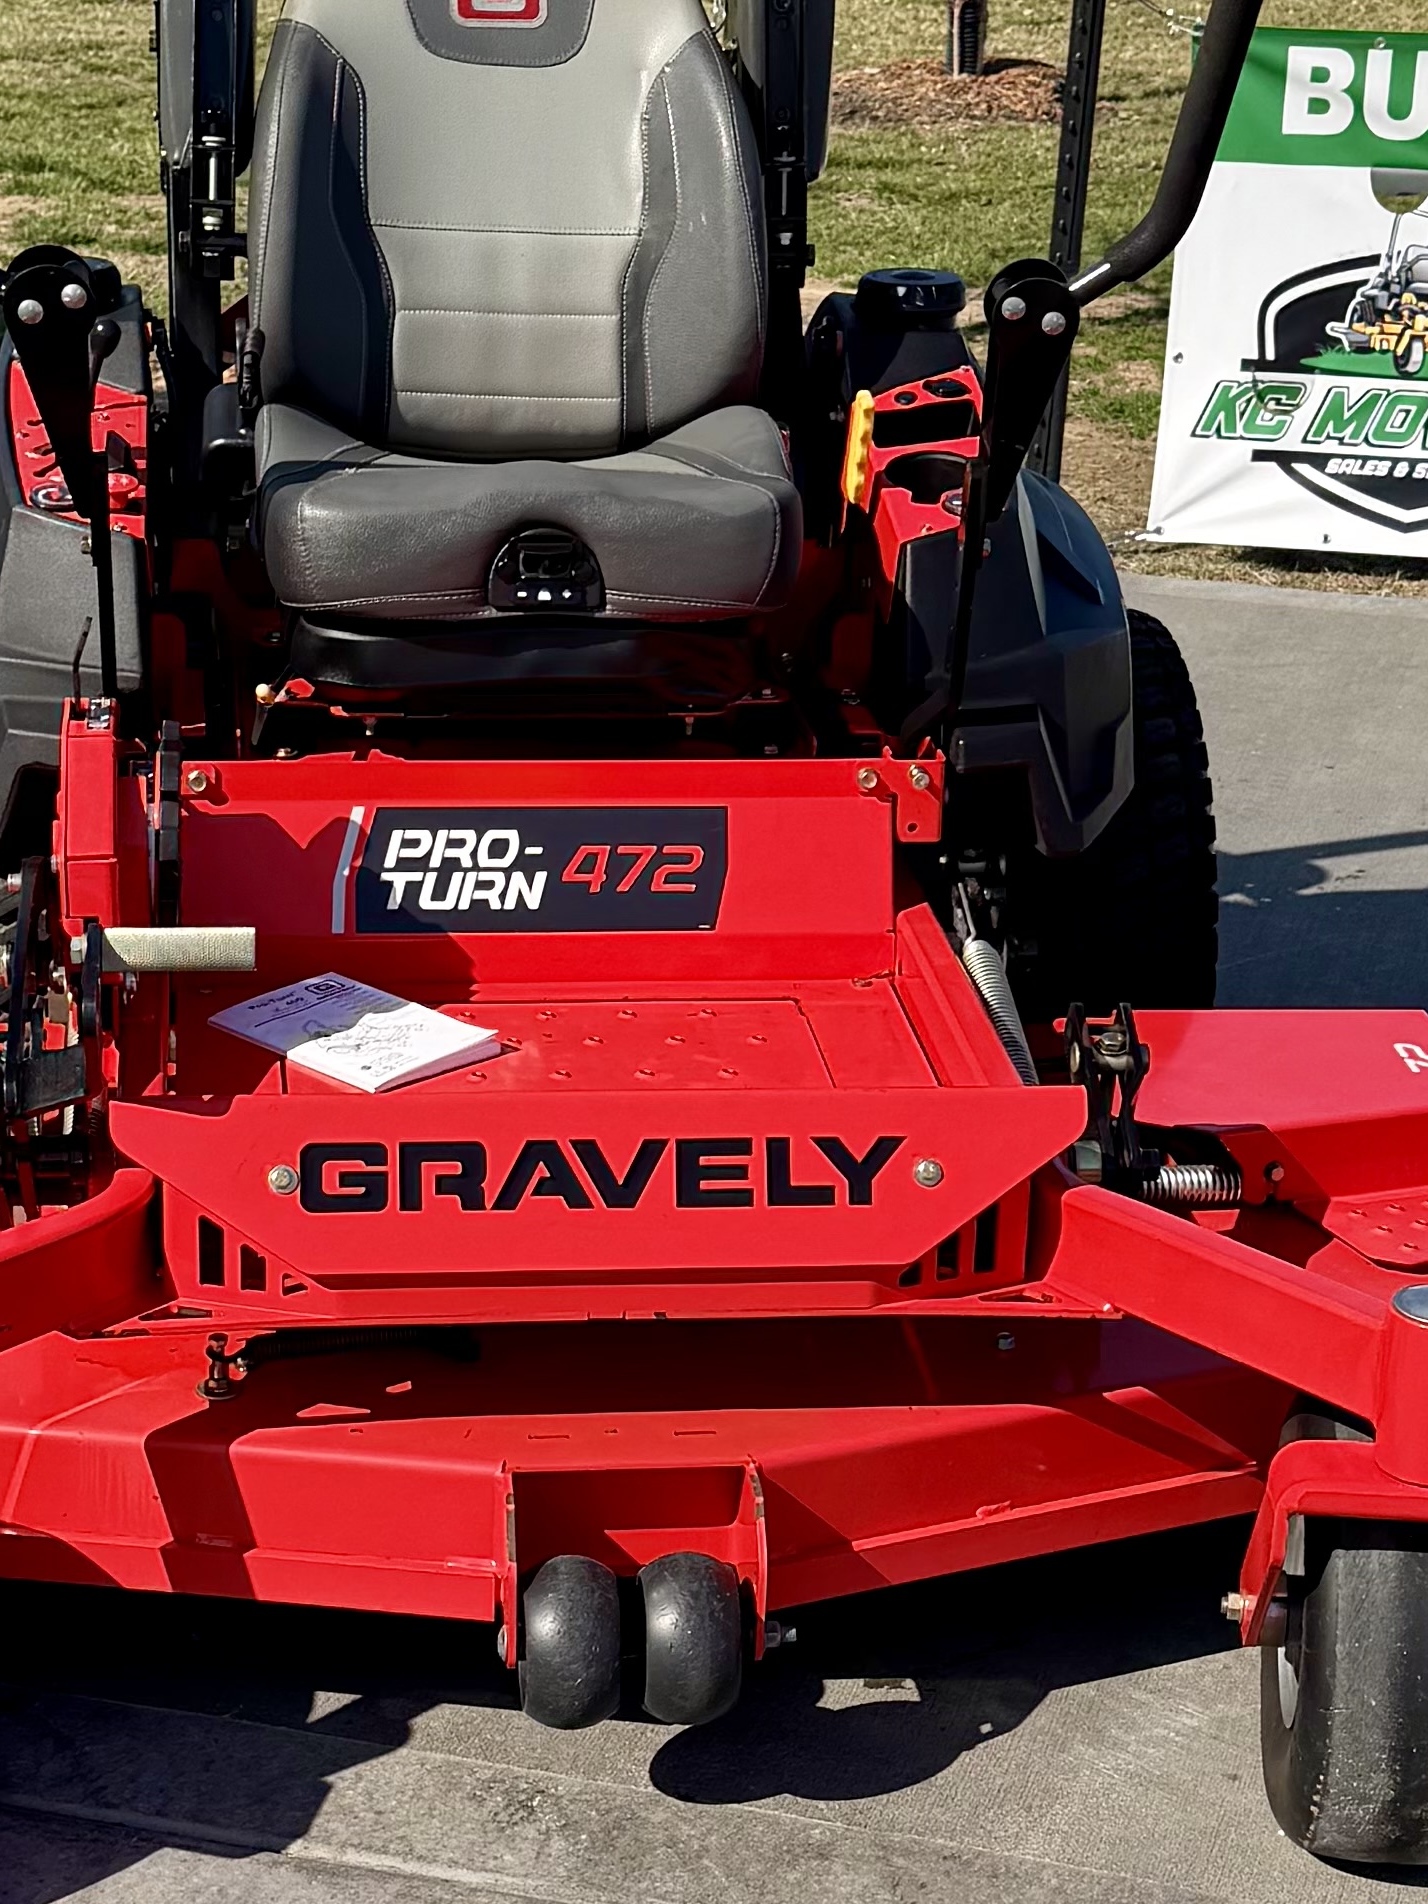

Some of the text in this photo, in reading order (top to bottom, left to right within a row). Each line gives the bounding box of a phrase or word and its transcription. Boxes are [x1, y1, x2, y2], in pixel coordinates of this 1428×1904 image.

[1191, 380, 1312, 441] KC
[1324, 458, 1391, 477] SALES
[1393, 461, 1409, 478] &
[383, 829, 544, 868] PRO-
[561, 843, 705, 894] 472
[380, 870, 548, 911] TURN
[299, 1135, 908, 1214] GRAVELY
